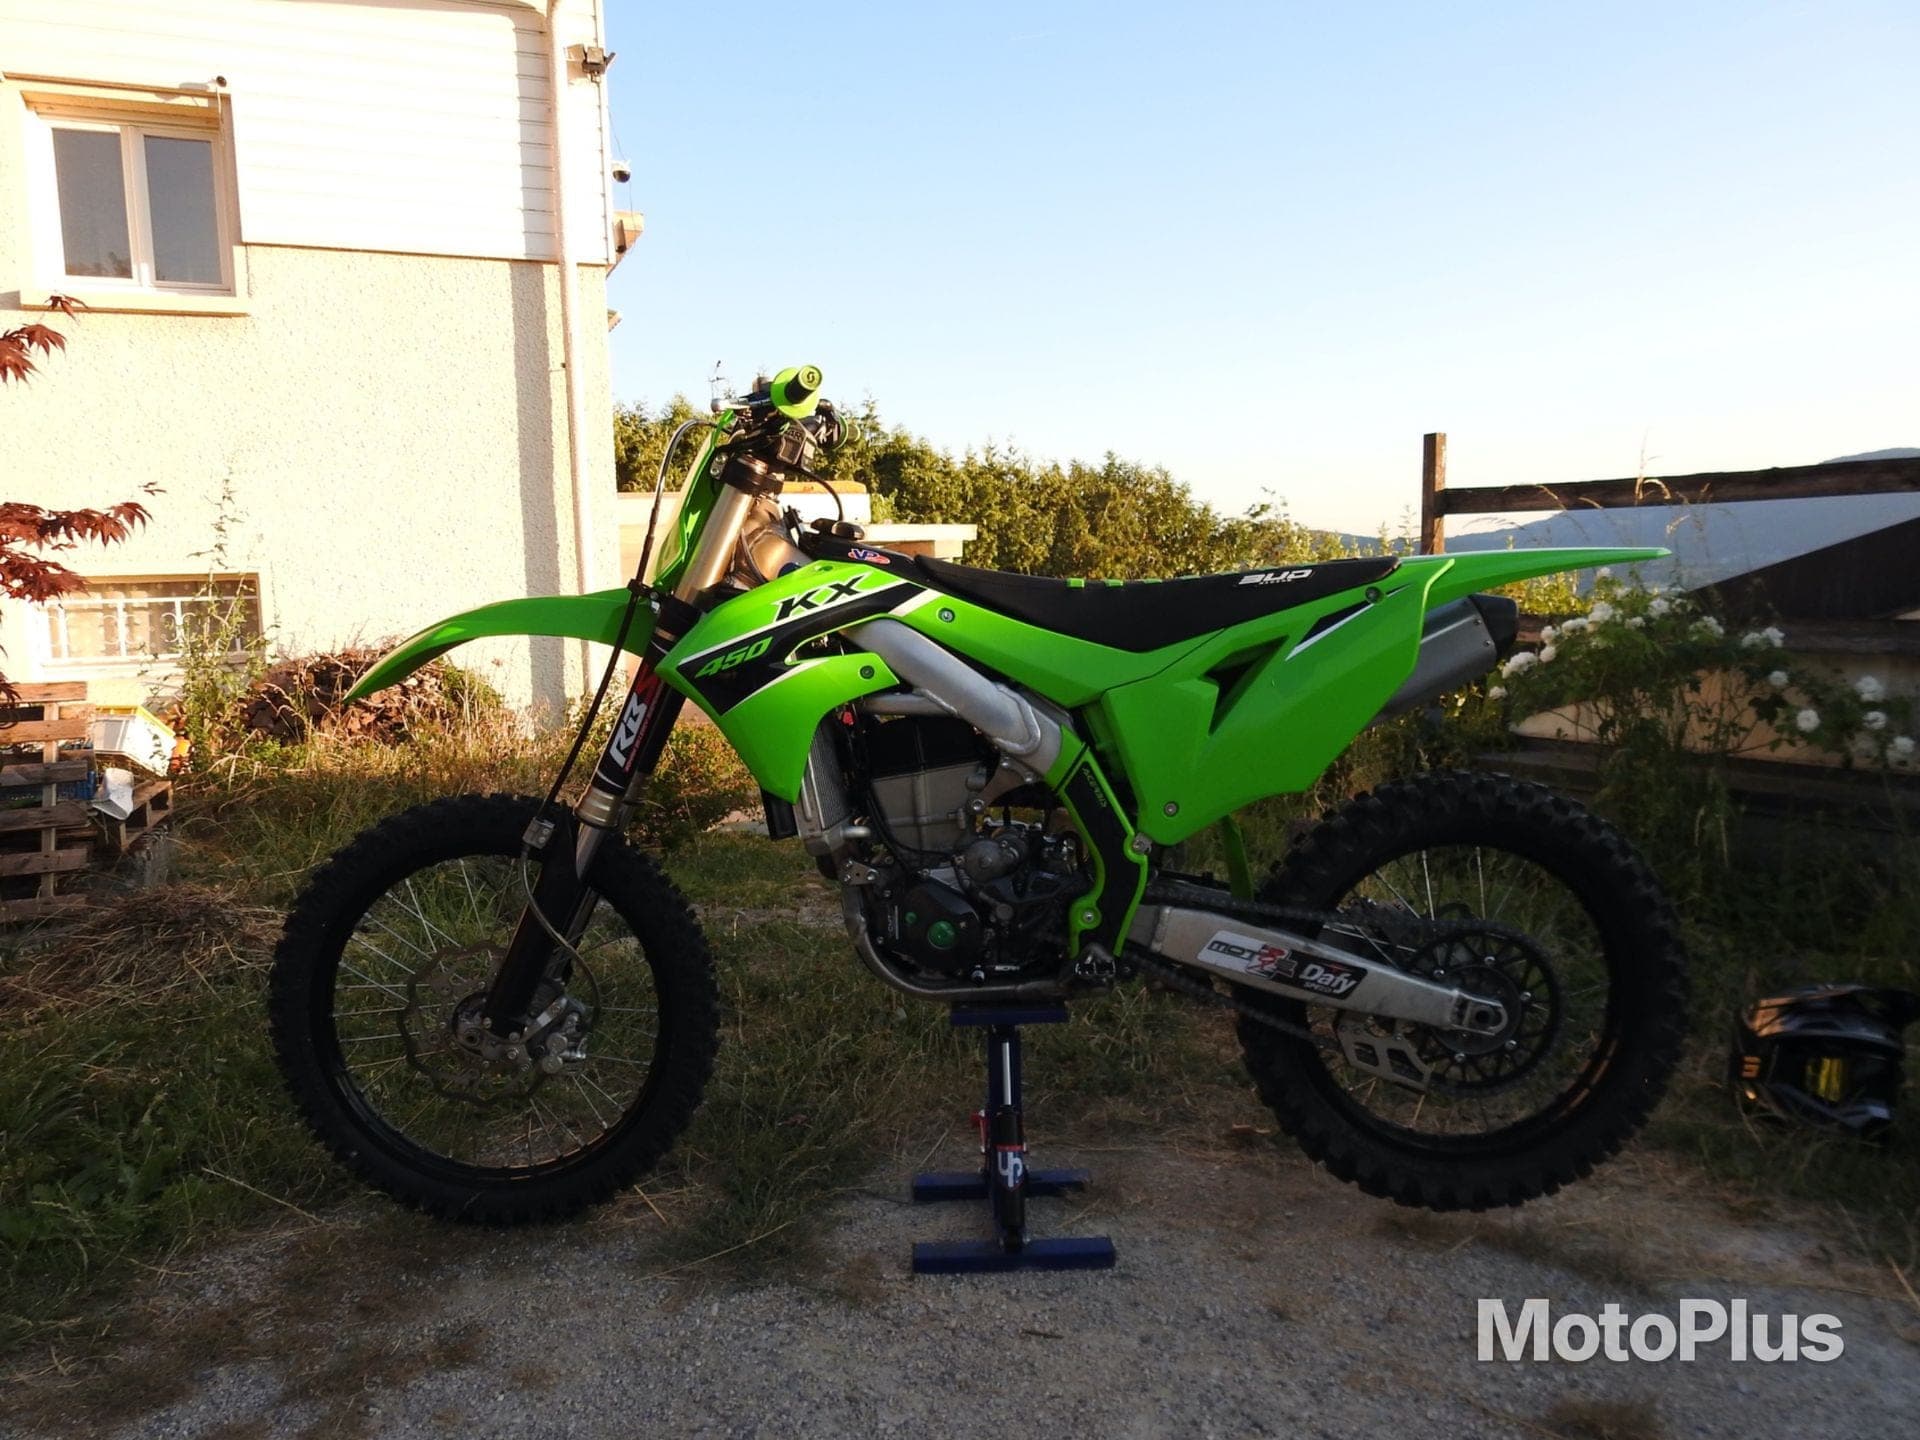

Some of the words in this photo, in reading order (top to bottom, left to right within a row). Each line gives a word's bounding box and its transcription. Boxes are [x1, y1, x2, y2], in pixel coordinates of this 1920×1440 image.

[774, 574, 872, 623] KX
[695, 637, 774, 678] 450
[1299, 964, 1358, 994] Dafy
